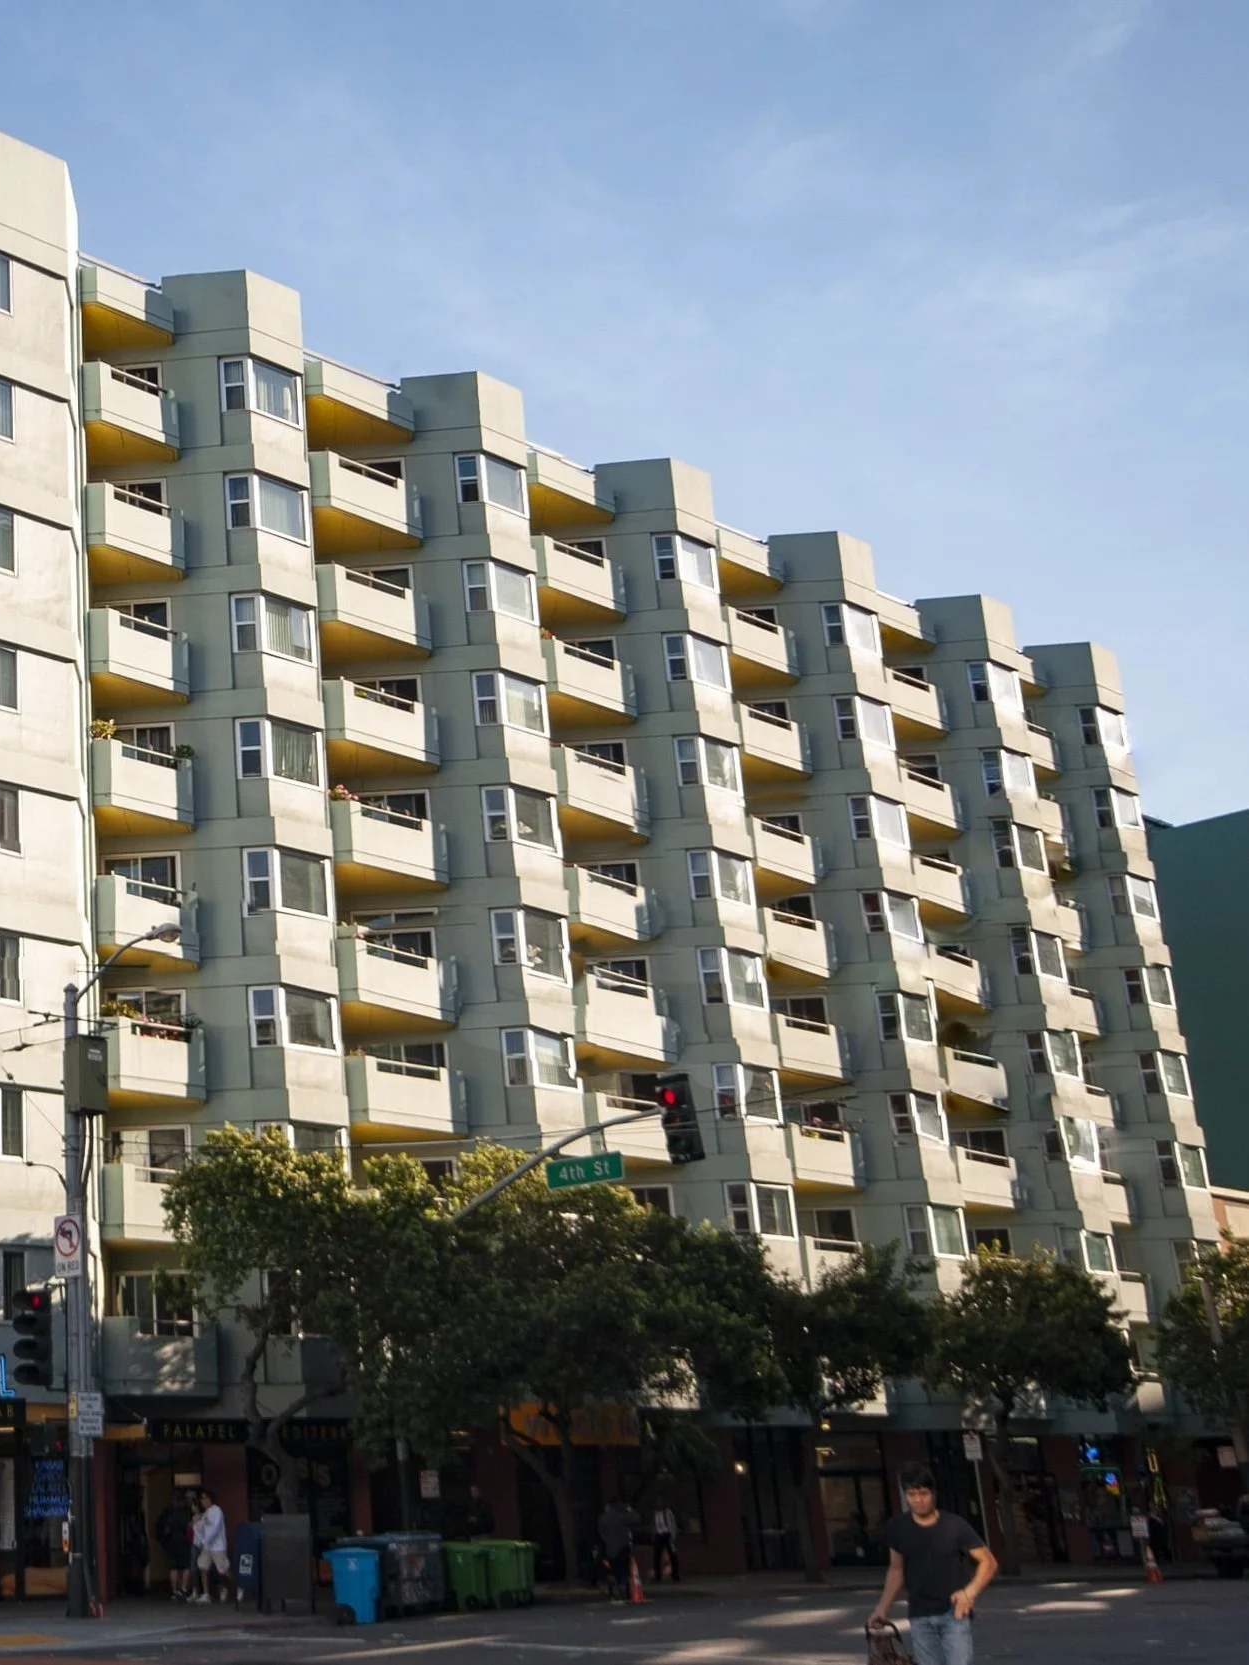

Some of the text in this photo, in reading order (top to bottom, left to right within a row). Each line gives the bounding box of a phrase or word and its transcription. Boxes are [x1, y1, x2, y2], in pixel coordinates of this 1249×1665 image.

[559, 1160, 610, 1180] 4th St
[56, 1260, 79, 1273] ON RED
[163, 1423, 237, 1440] FALAFEL
[260, 1457, 330, 1488] OSIS
